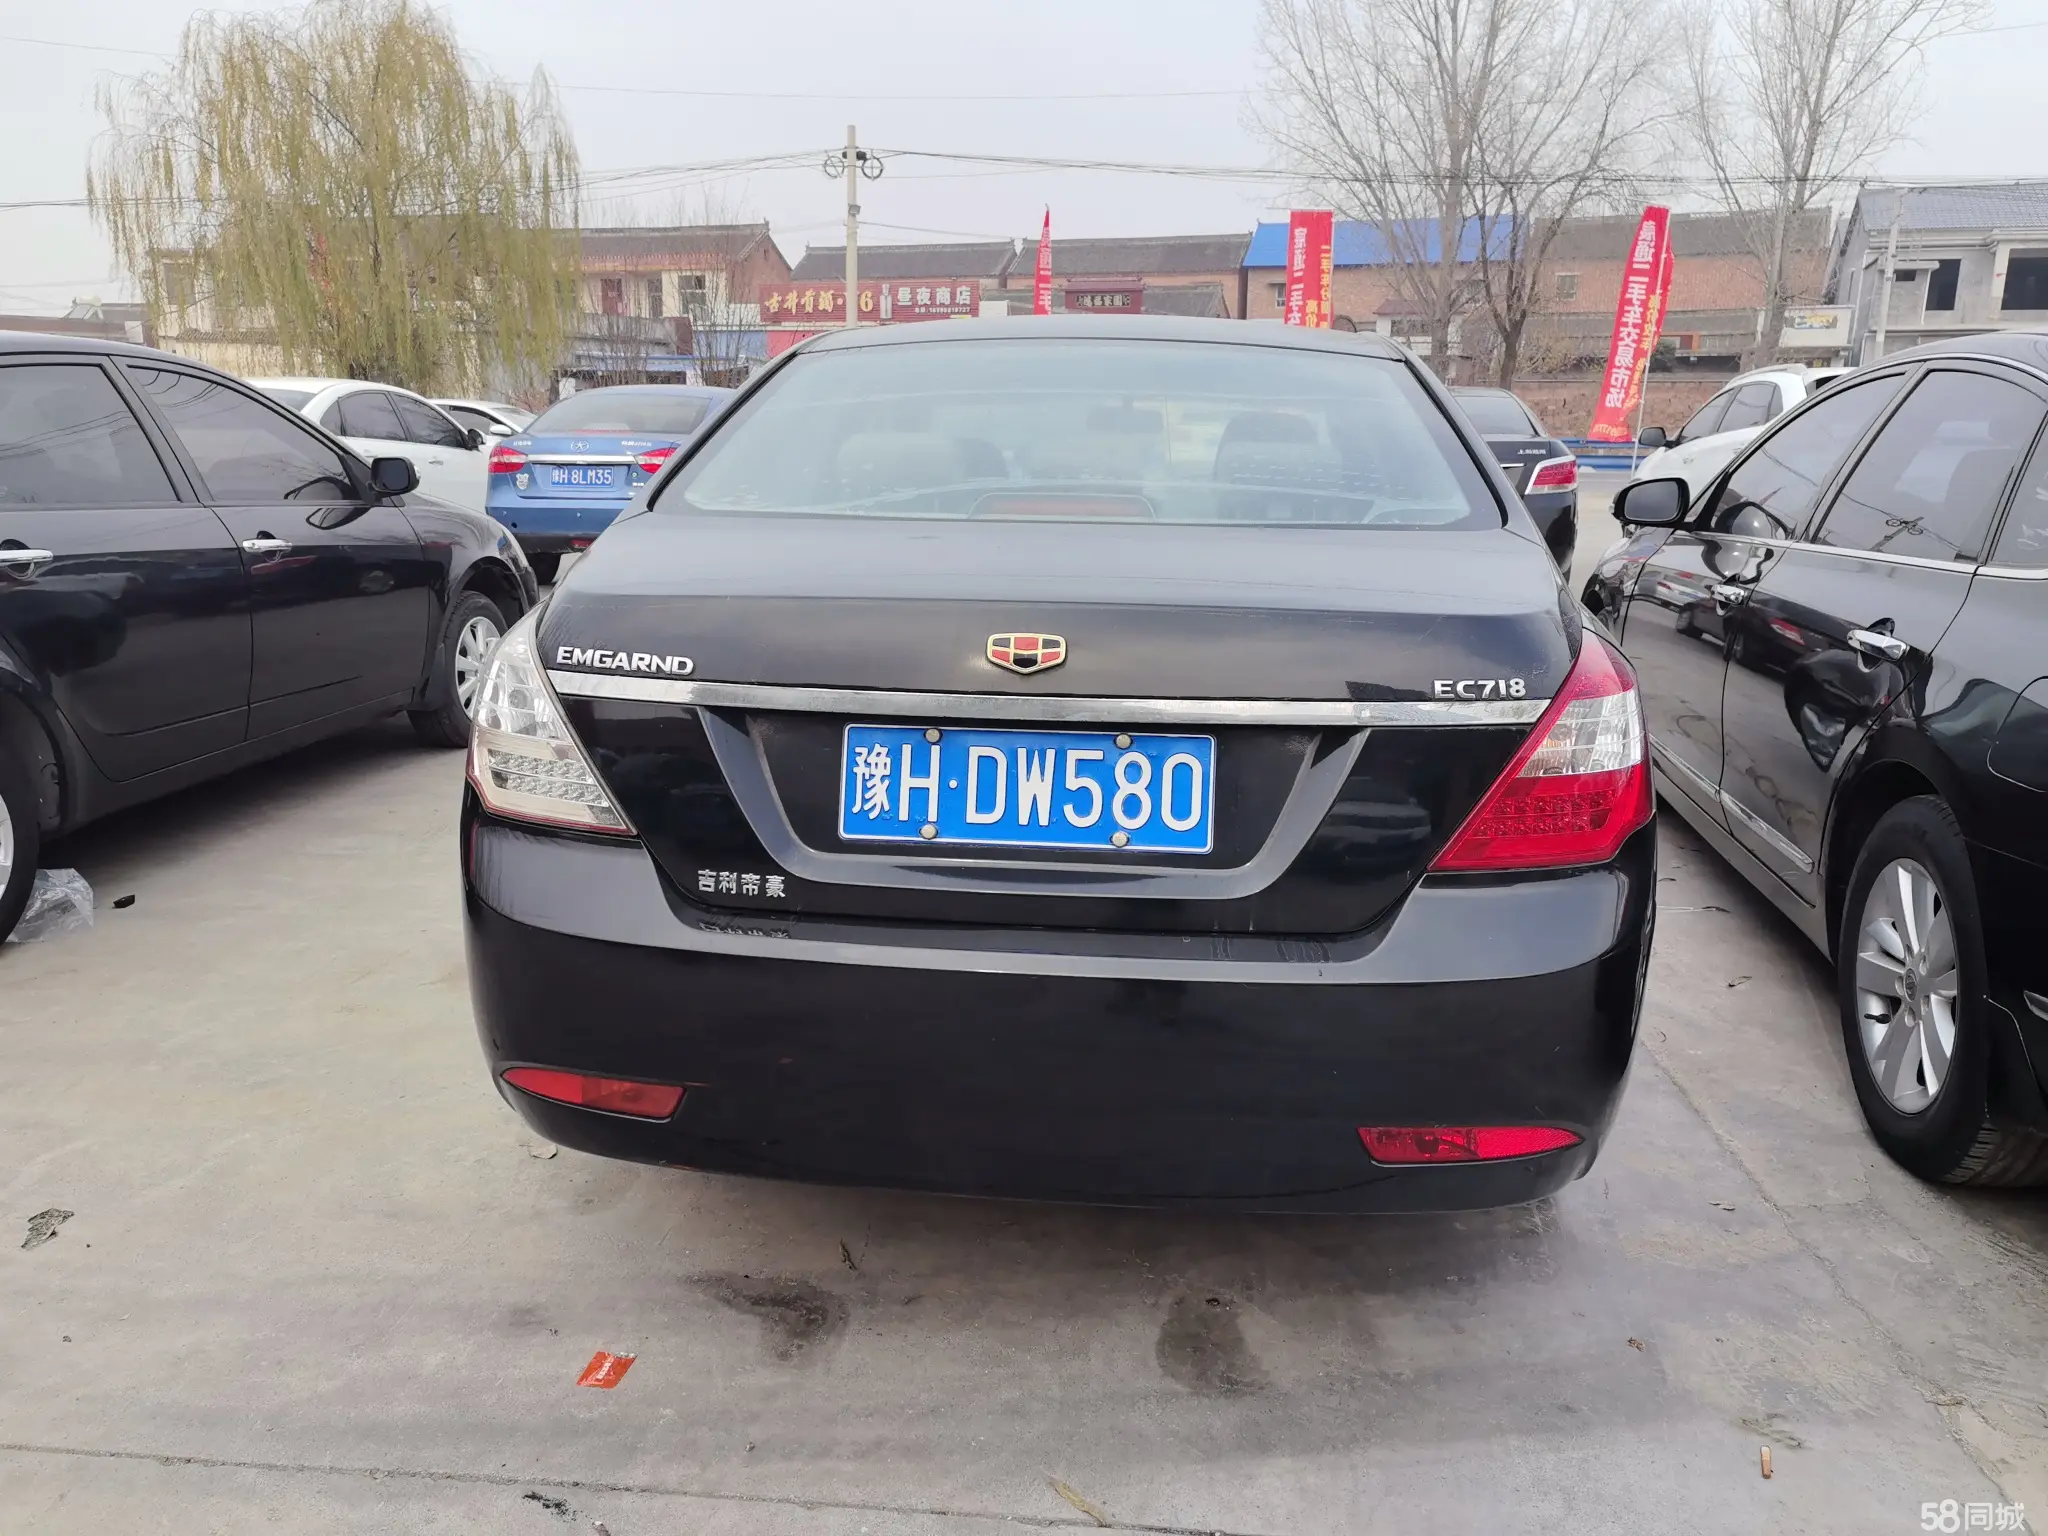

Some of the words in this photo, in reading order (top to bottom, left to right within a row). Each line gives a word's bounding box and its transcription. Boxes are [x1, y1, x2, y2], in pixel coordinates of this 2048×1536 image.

[765, 288, 874, 315] 古井贡酒·6
[897, 285, 971, 306] 昼夜商店
[556, 646, 694, 676] EMGARND
[1433, 678, 1527, 699] EC718
[852, 742, 1203, 832] 豫H·DW580
[698, 869, 786, 898] 吉利帝豪
